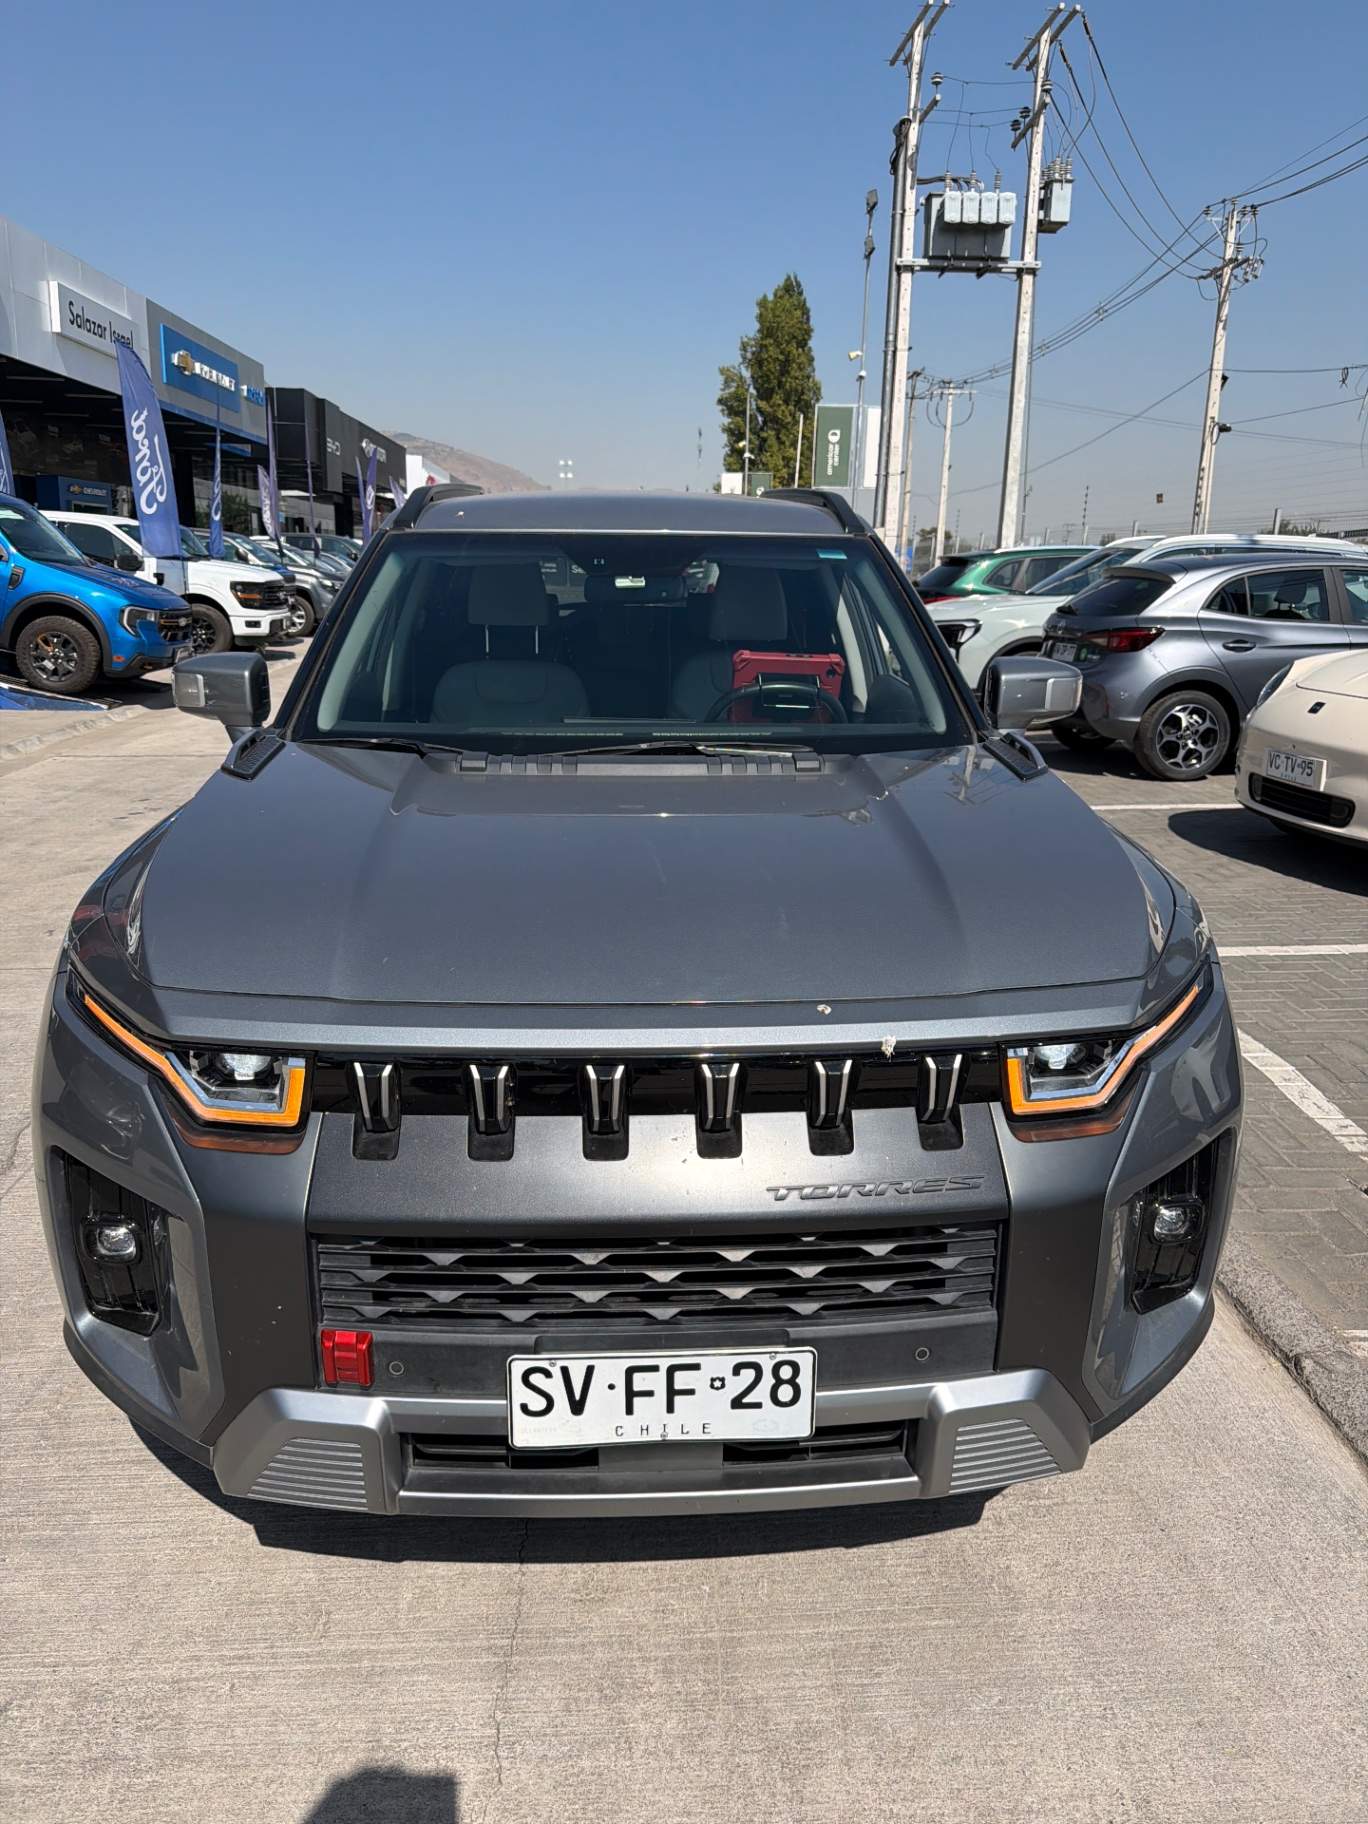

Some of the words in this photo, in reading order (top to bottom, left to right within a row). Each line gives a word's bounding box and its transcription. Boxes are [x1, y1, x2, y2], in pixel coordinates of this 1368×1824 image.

[68, 300, 107, 340] Salazar
[766, 1175, 985, 1201] TORRES
[614, 1422, 712, 1438] CHILE
